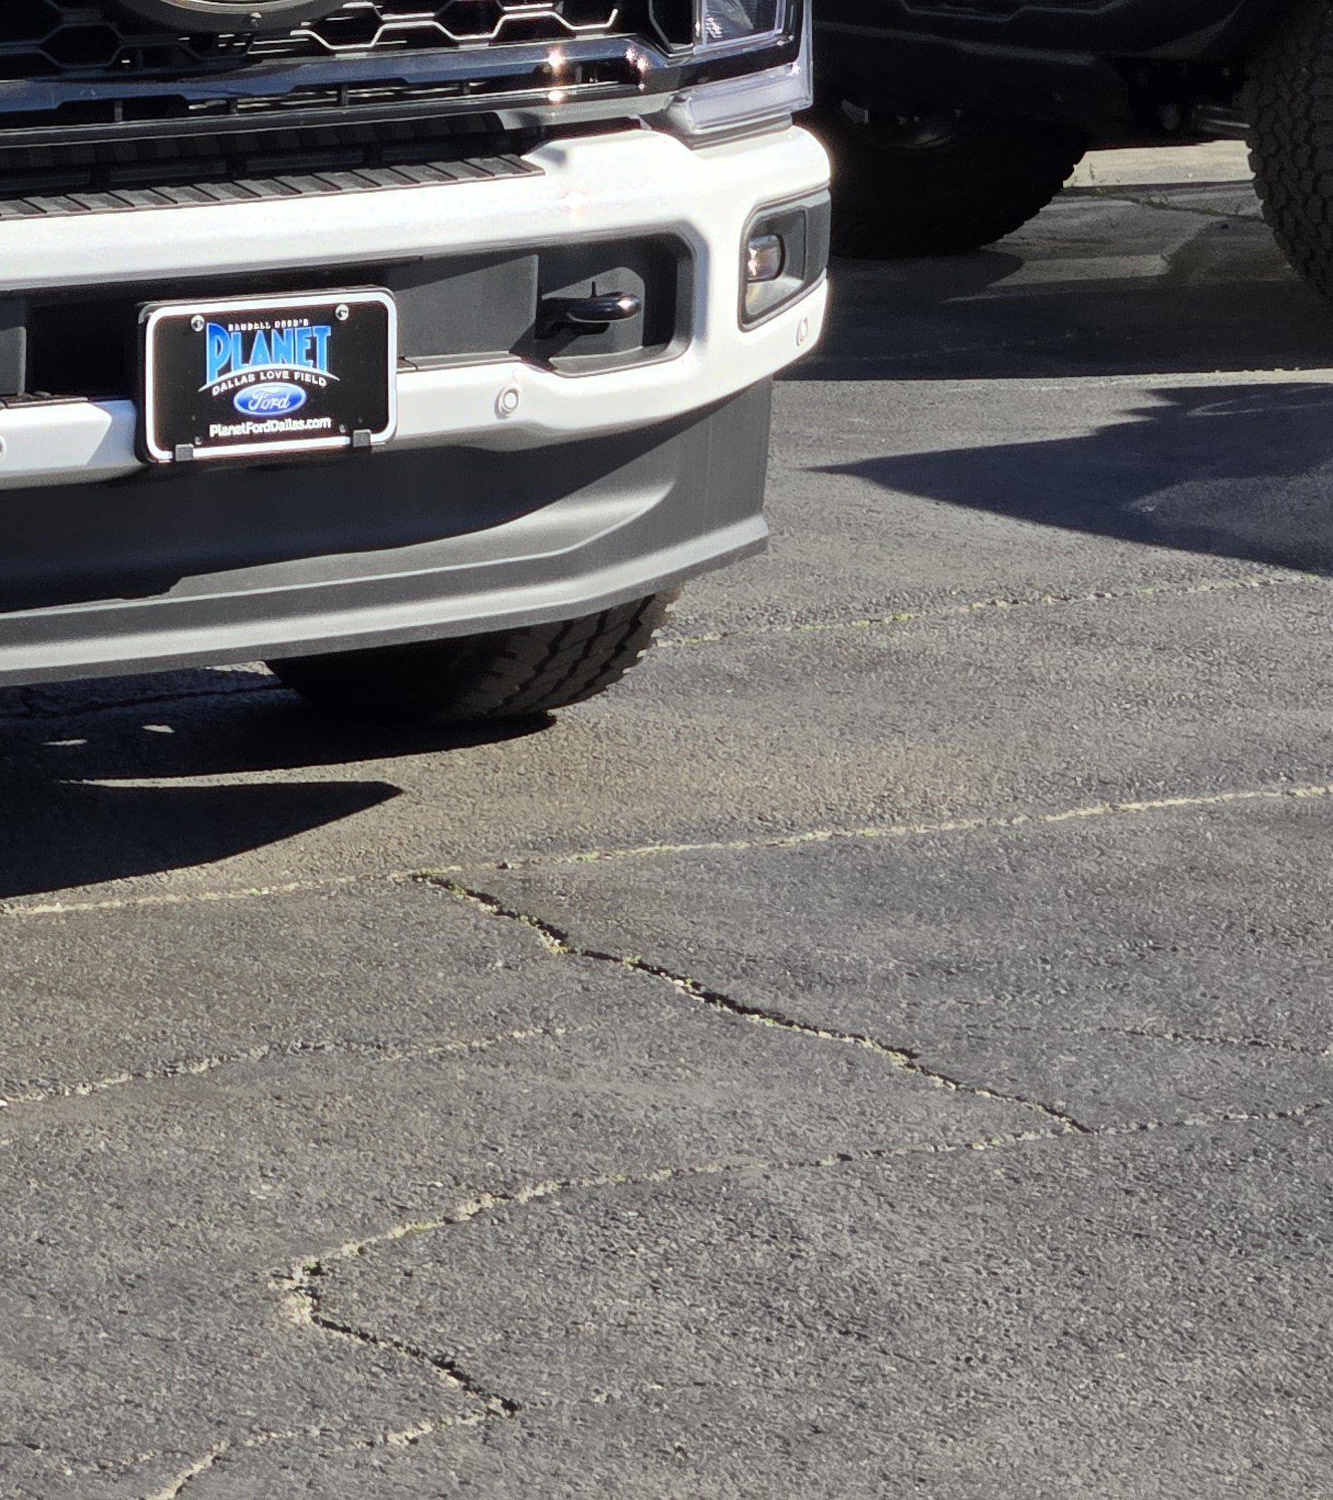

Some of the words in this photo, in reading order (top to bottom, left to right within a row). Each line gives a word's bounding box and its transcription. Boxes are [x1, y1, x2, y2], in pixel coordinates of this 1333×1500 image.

[205, 322, 332, 386] PLANET
[211, 373, 256, 397] DALLAS
[260, 370, 290, 381] LOVE
[293, 371, 328, 387] FIELD
[247, 389, 291, 411] Ford
